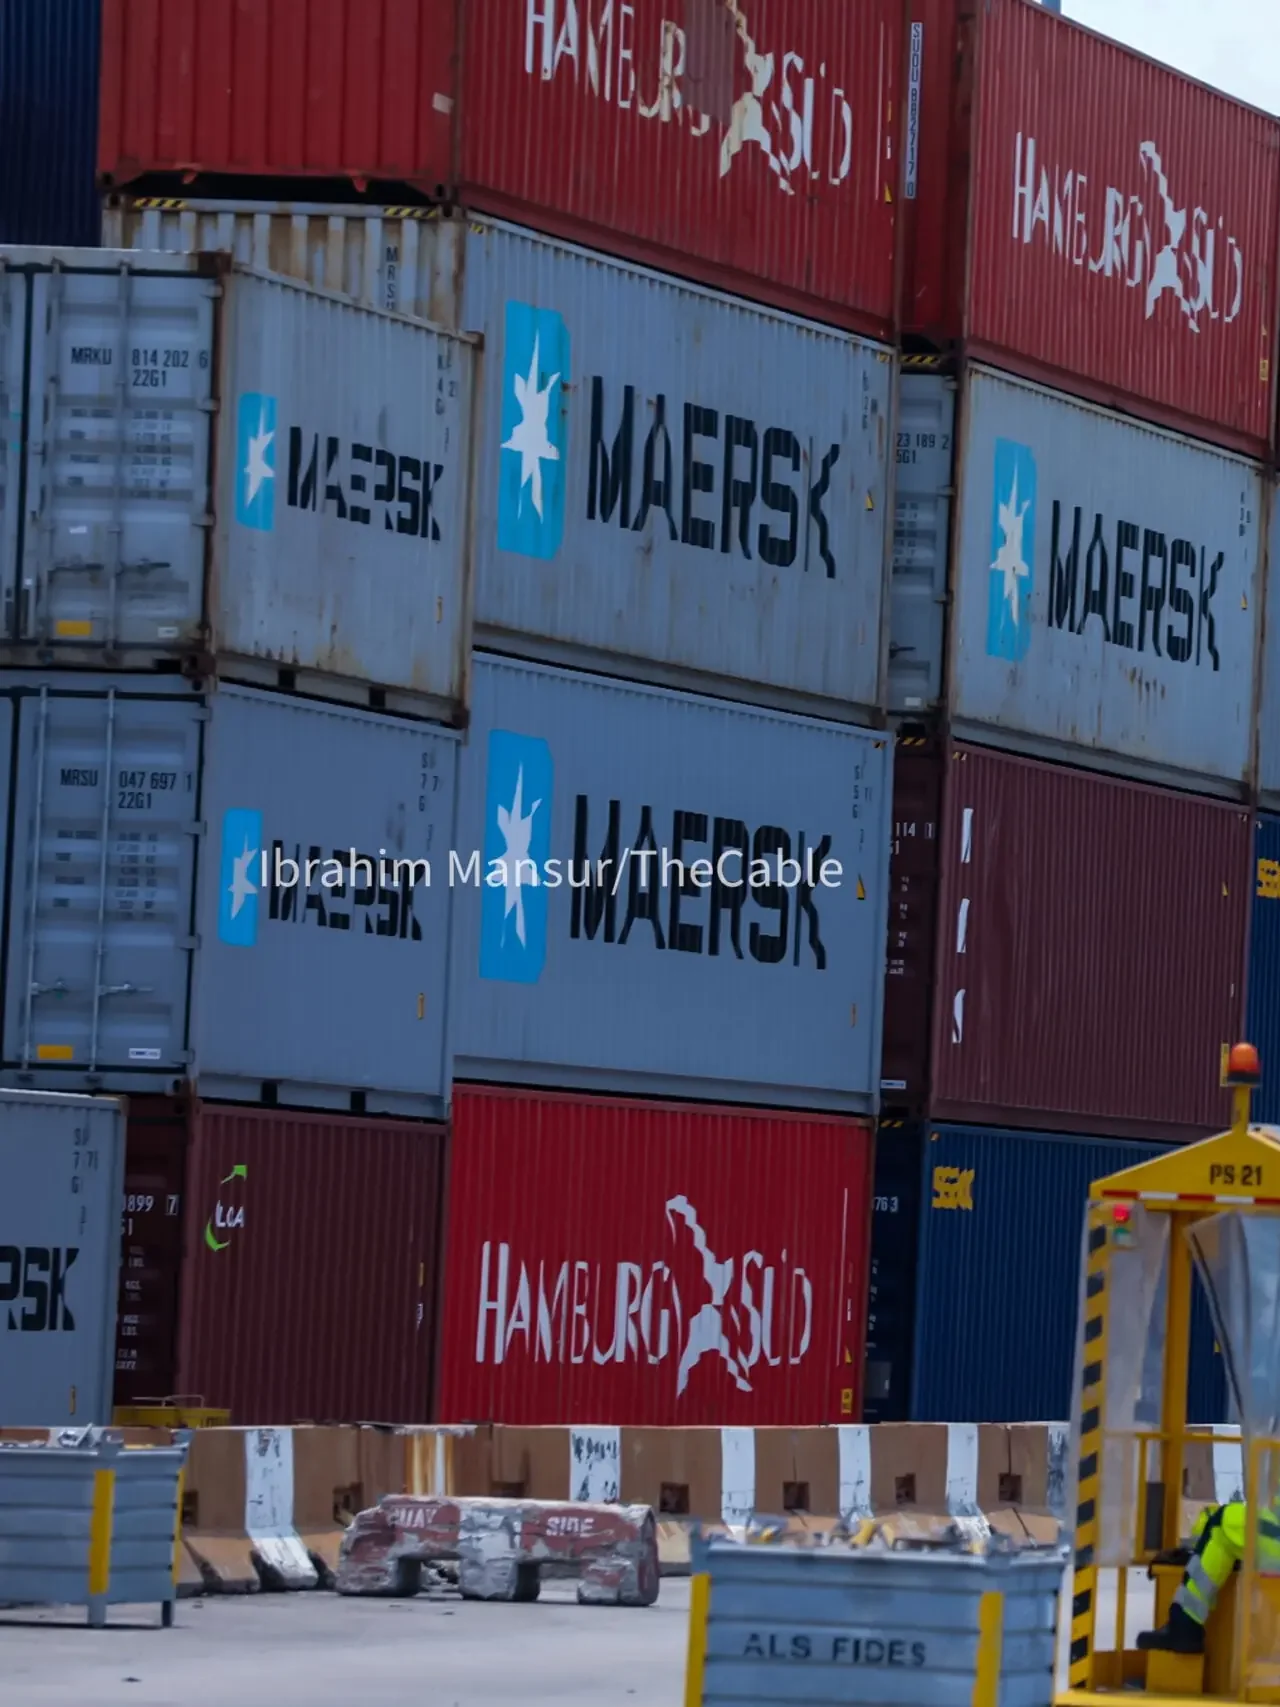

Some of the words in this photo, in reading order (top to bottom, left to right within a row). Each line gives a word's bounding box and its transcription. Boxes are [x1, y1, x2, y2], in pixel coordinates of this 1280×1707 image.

[71, 347, 112, 366] MRKU
[132, 349, 158, 367] 814
[163, 349, 189, 368] 202
[132, 369, 167, 388] 22G1
[586, 375, 840, 579] MAERSK
[1048, 500, 1225, 672] MAERSK
[60, 768, 98, 787] MRSU
[119, 770, 146, 789] 047
[151, 772, 177, 791] 697
[118, 792, 152, 809] 22G1
[570, 794, 832, 970] MAERSK
[1209, 1164, 1235, 1186] PS
[1240, 1165, 1263, 1187] 21
[475, 1241, 671, 1365] HAMBURG
[546, 1515, 594, 1538] SIDE
[743, 1632, 811, 1660] ALS
[832, 1635, 927, 1667] FIDES
